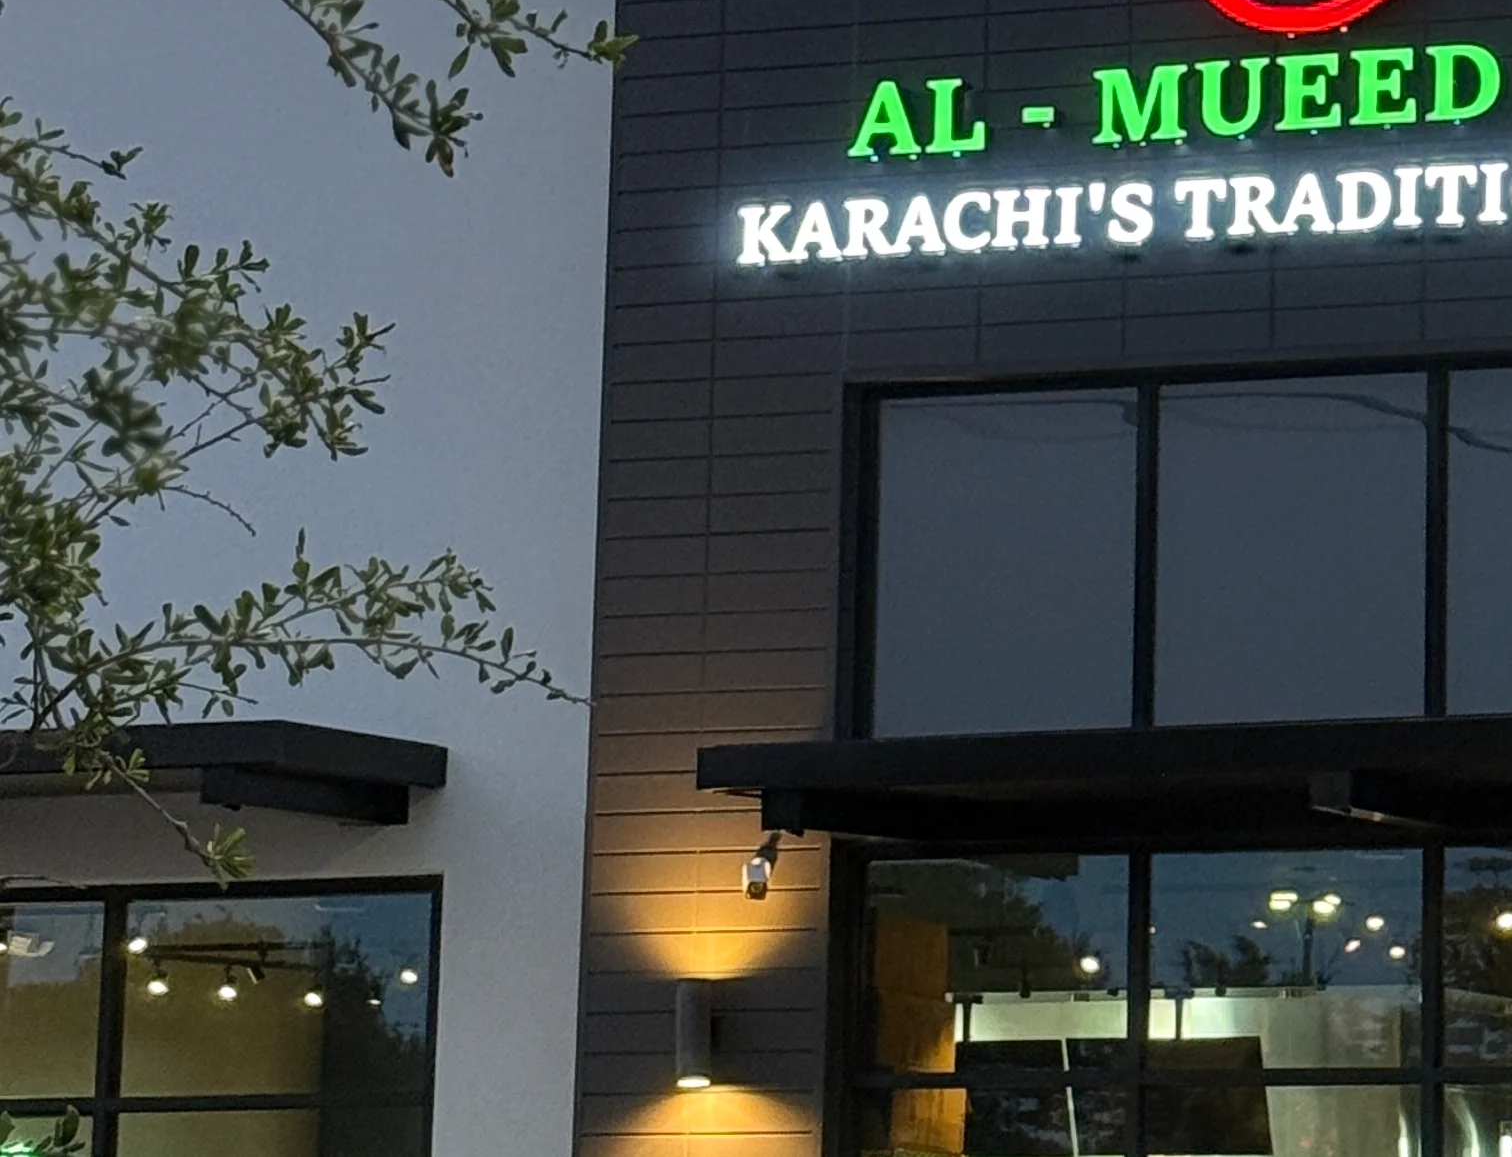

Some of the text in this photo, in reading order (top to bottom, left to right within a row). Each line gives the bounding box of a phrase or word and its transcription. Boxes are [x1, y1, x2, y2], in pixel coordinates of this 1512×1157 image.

[847, 77, 986, 156] AL
[1093, 45, 1501, 145] MUEED
[736, 182, 1155, 266] KARACHI'S
